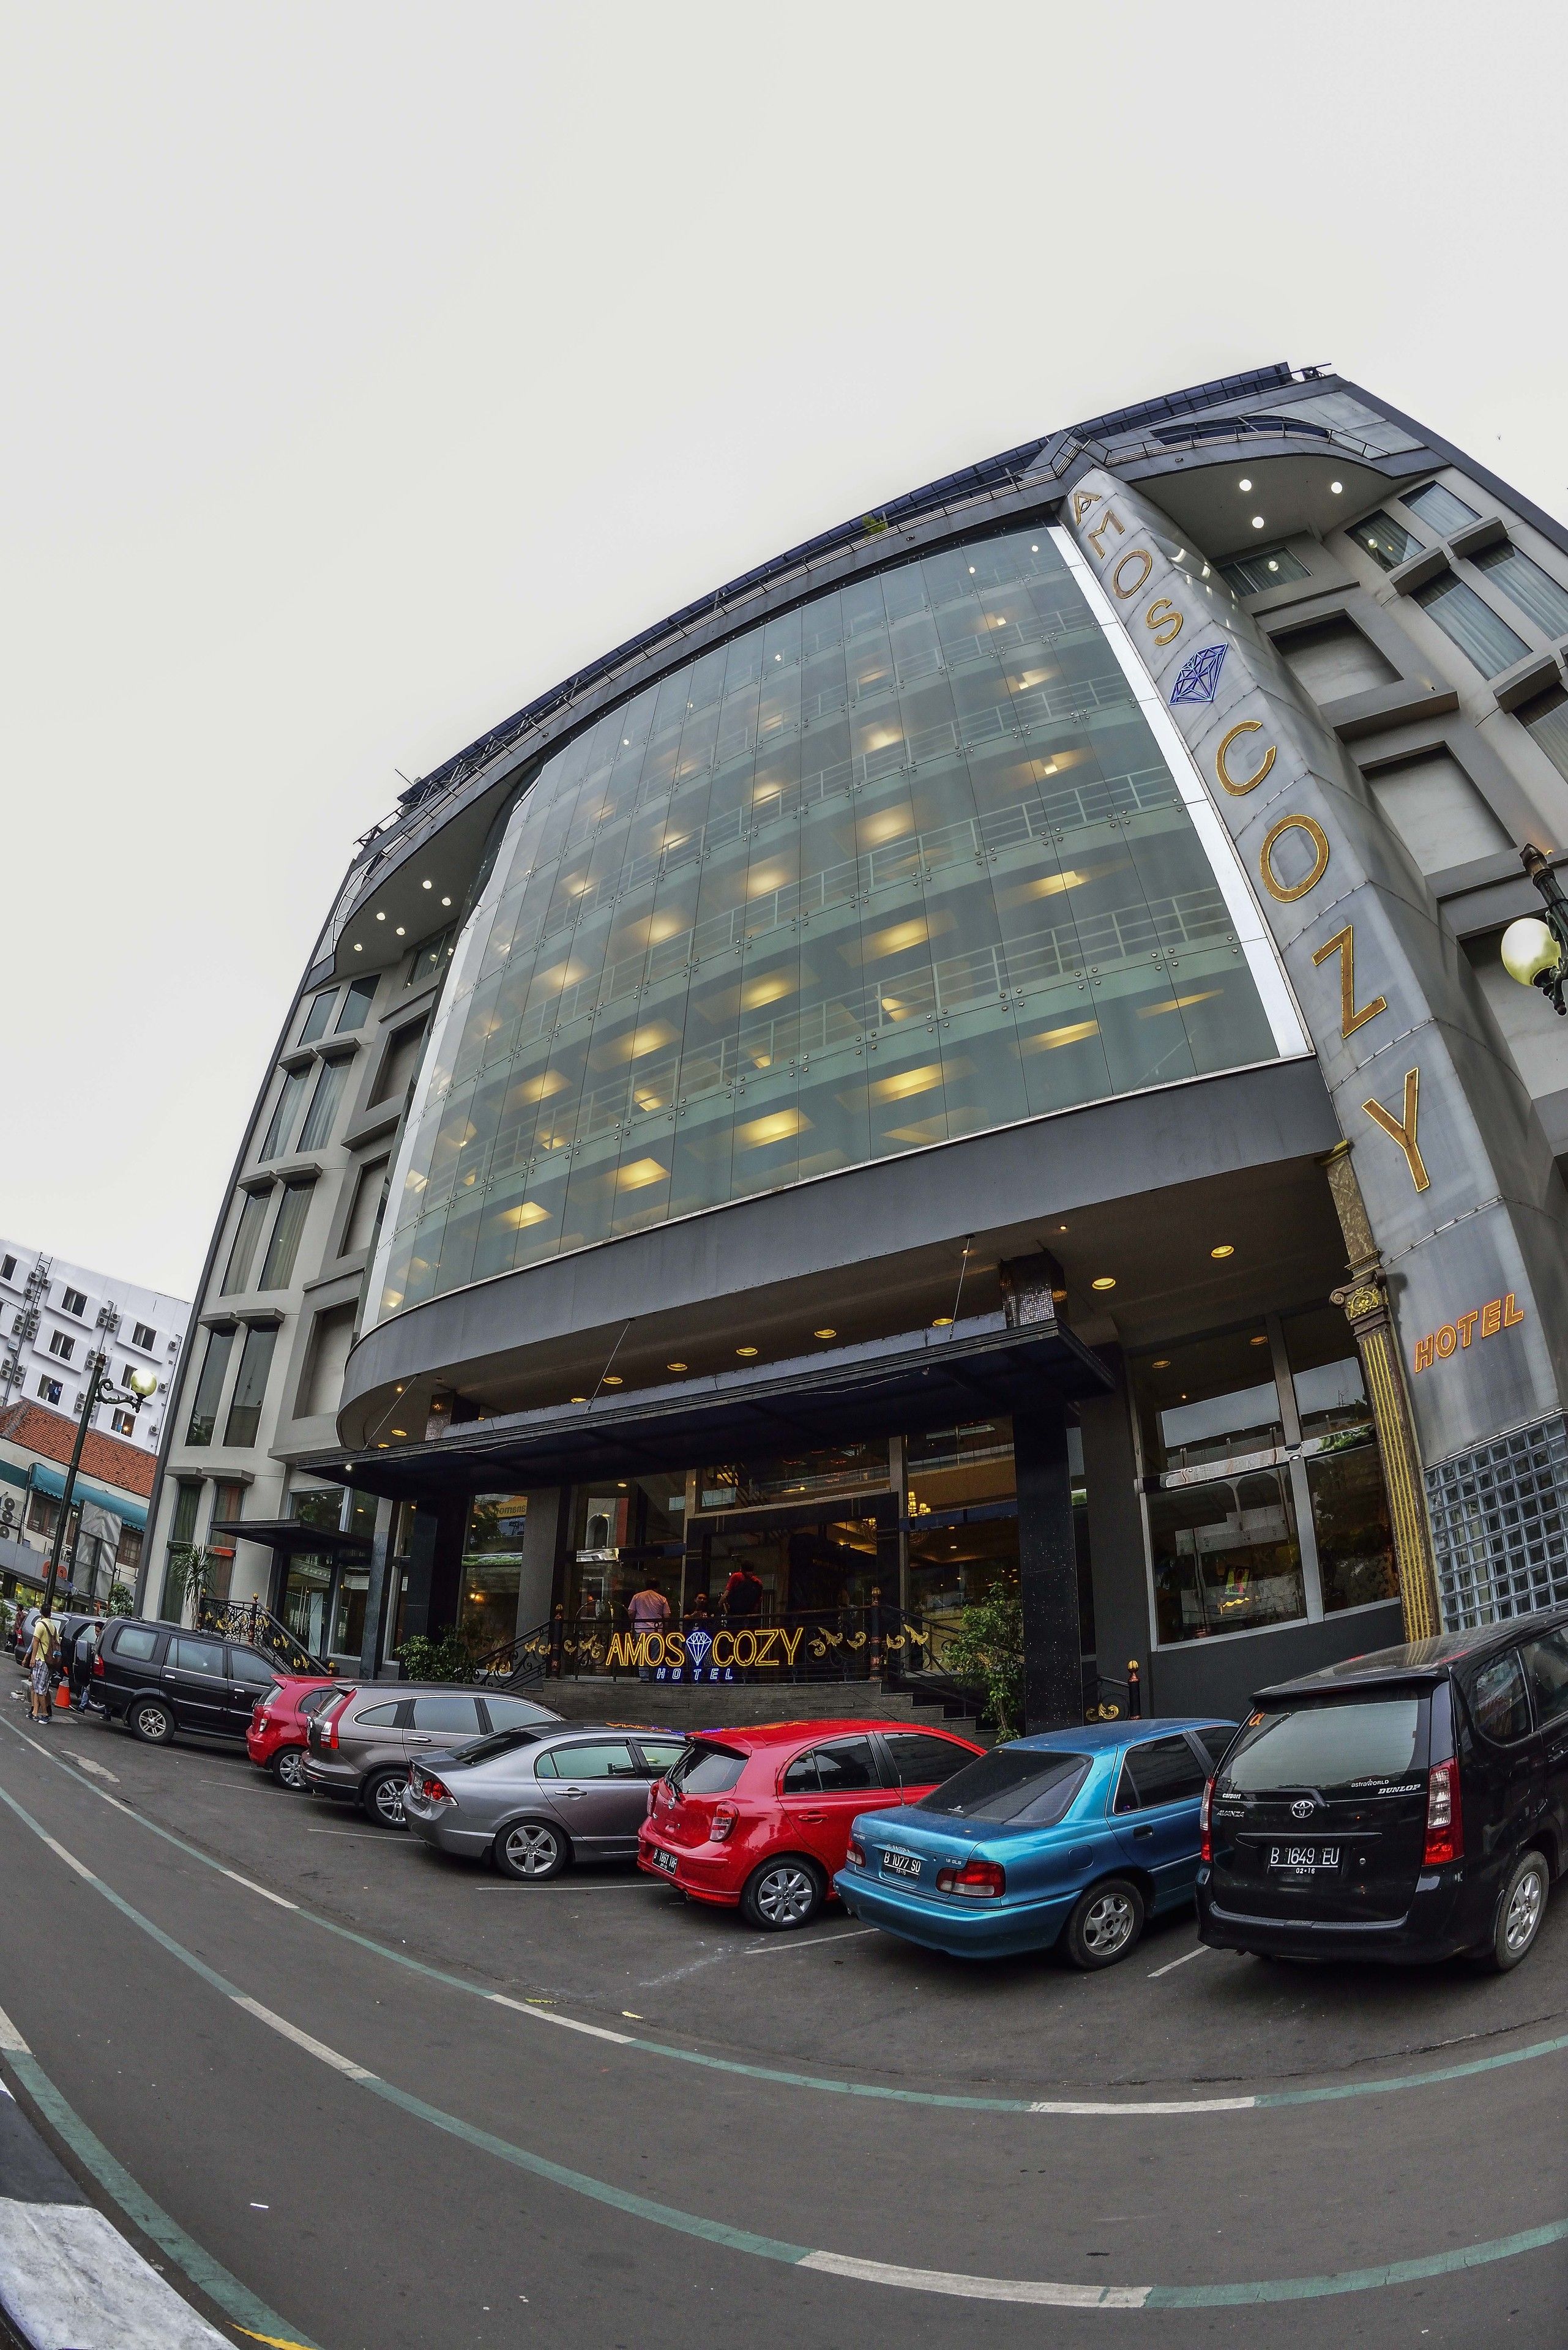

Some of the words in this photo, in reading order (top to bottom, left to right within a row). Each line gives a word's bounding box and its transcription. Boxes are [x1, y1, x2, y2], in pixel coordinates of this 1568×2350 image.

[1072, 490, 1184, 646] AMOS
[1216, 720, 1430, 1192] COZY
[1414, 1293, 1525, 1373] HOTEL
[606, 1632, 685, 1666] AMOS
[712, 1628, 804, 1666] COZY
[656, 1668, 733, 1680] HOTEL
[1378, 1784, 1421, 1794] DUNLOP
[654, 1849, 658, 1859] B
[884, 1851, 890, 1863] B
[892, 1854, 909, 1869] 1077
[1270, 1847, 1280, 1864] B
[1287, 1847, 1315, 1864] 1649
[1323, 1847, 1340, 1865] EU
